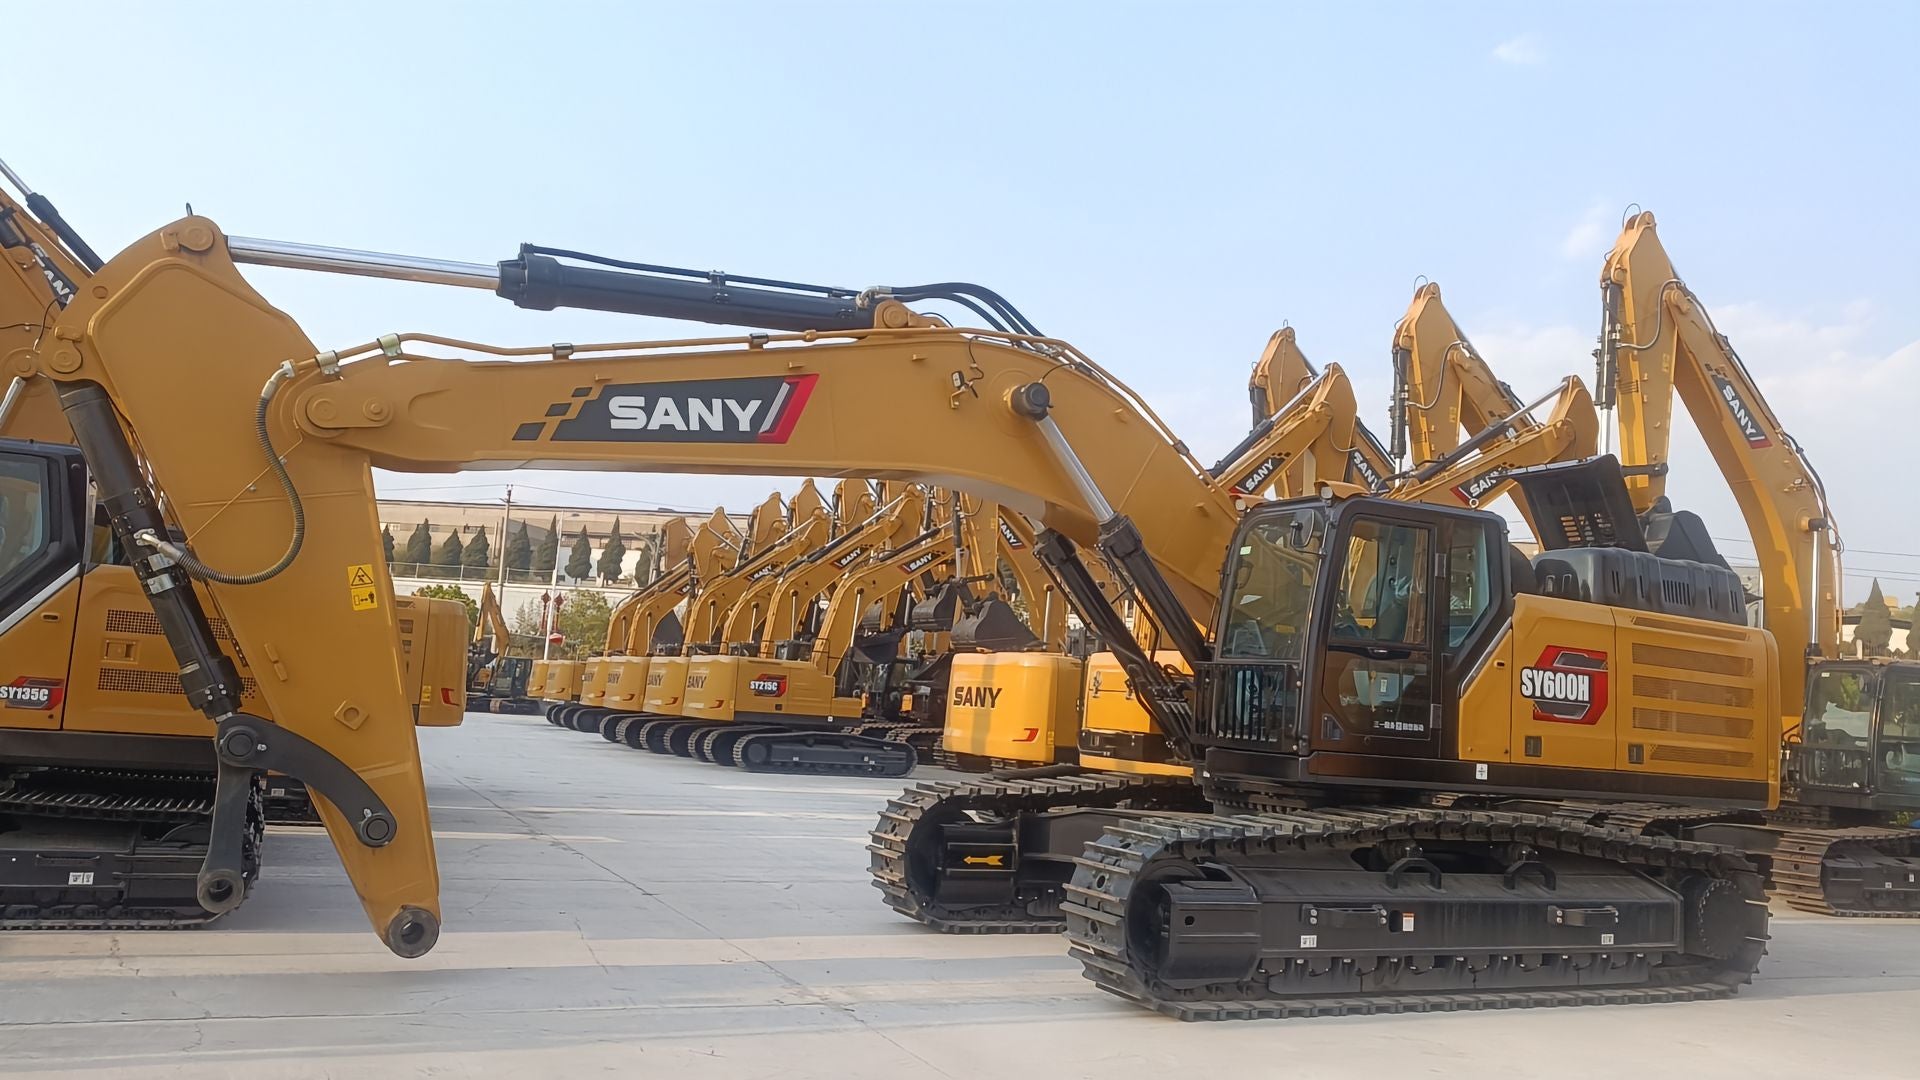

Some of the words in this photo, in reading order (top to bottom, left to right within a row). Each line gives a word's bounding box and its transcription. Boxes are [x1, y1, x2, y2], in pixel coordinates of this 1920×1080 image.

[608, 395, 762, 432] SANY
[1722, 385, 1757, 435] SANY
[1245, 458, 1273, 491] SANY
[1469, 466, 1503, 497] SAN
[840, 548, 861, 566] SANY
[909, 553, 933, 571] SANY
[0, 686, 49, 701] SY135C
[686, 675, 707, 689] SANY
[750, 680, 778, 691] SY215C
[1521, 668, 1590, 702] SY600H
[953, 686, 1003, 709] SANY
